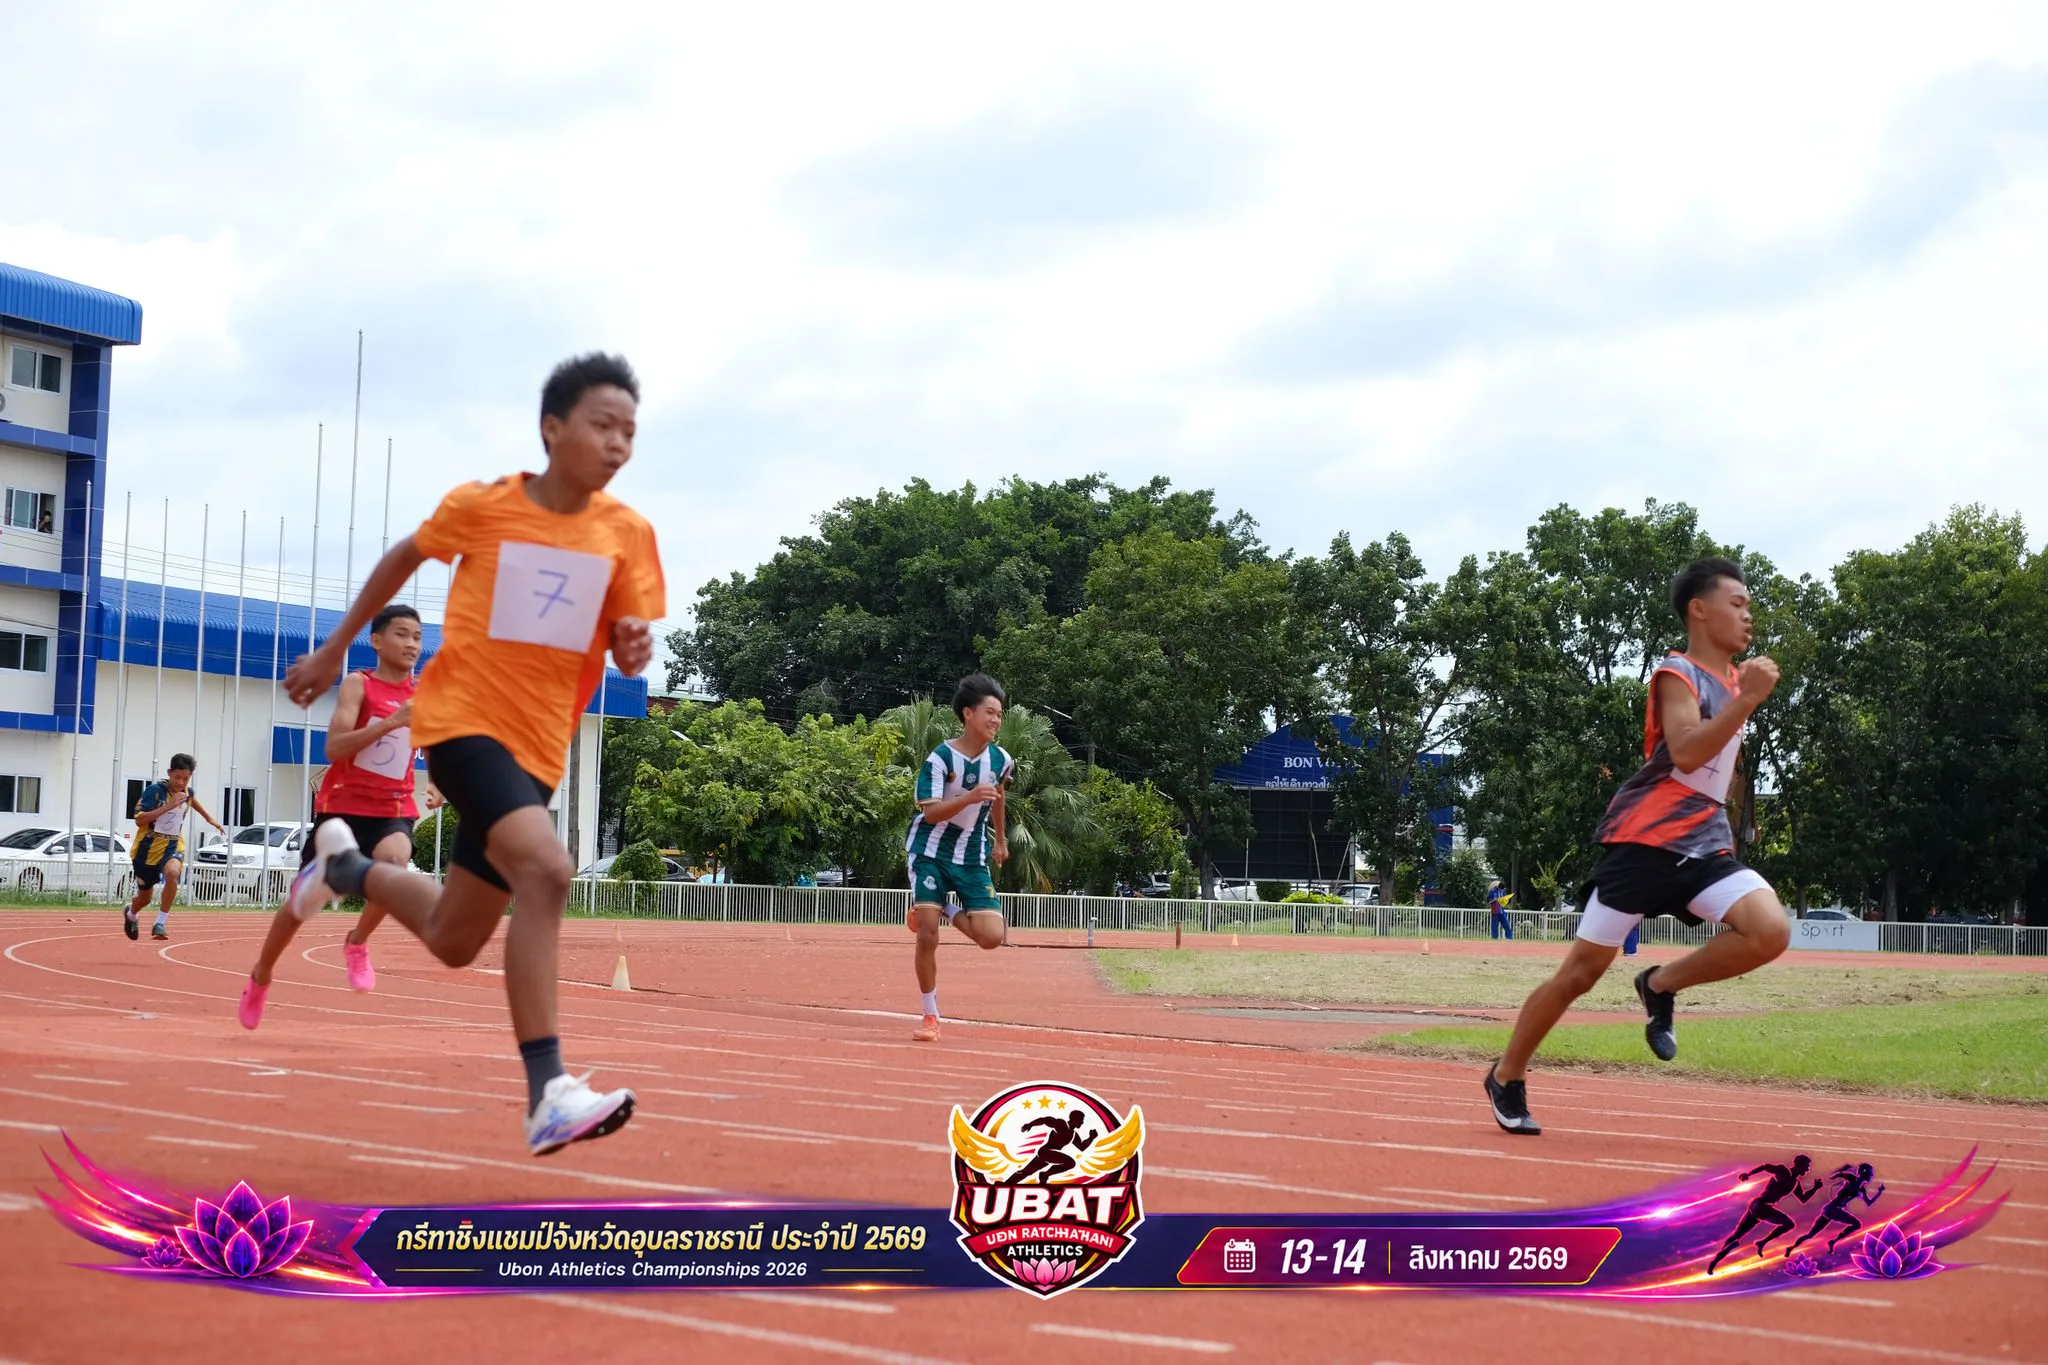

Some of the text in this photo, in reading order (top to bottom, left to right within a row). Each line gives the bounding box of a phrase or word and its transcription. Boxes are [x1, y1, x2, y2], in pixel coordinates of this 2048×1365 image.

[533, 569, 575, 619] 7
[371, 734, 399, 766] 5
[1283, 757, 1313, 768] BON
[1801, 922, 1844, 939] Sprt
